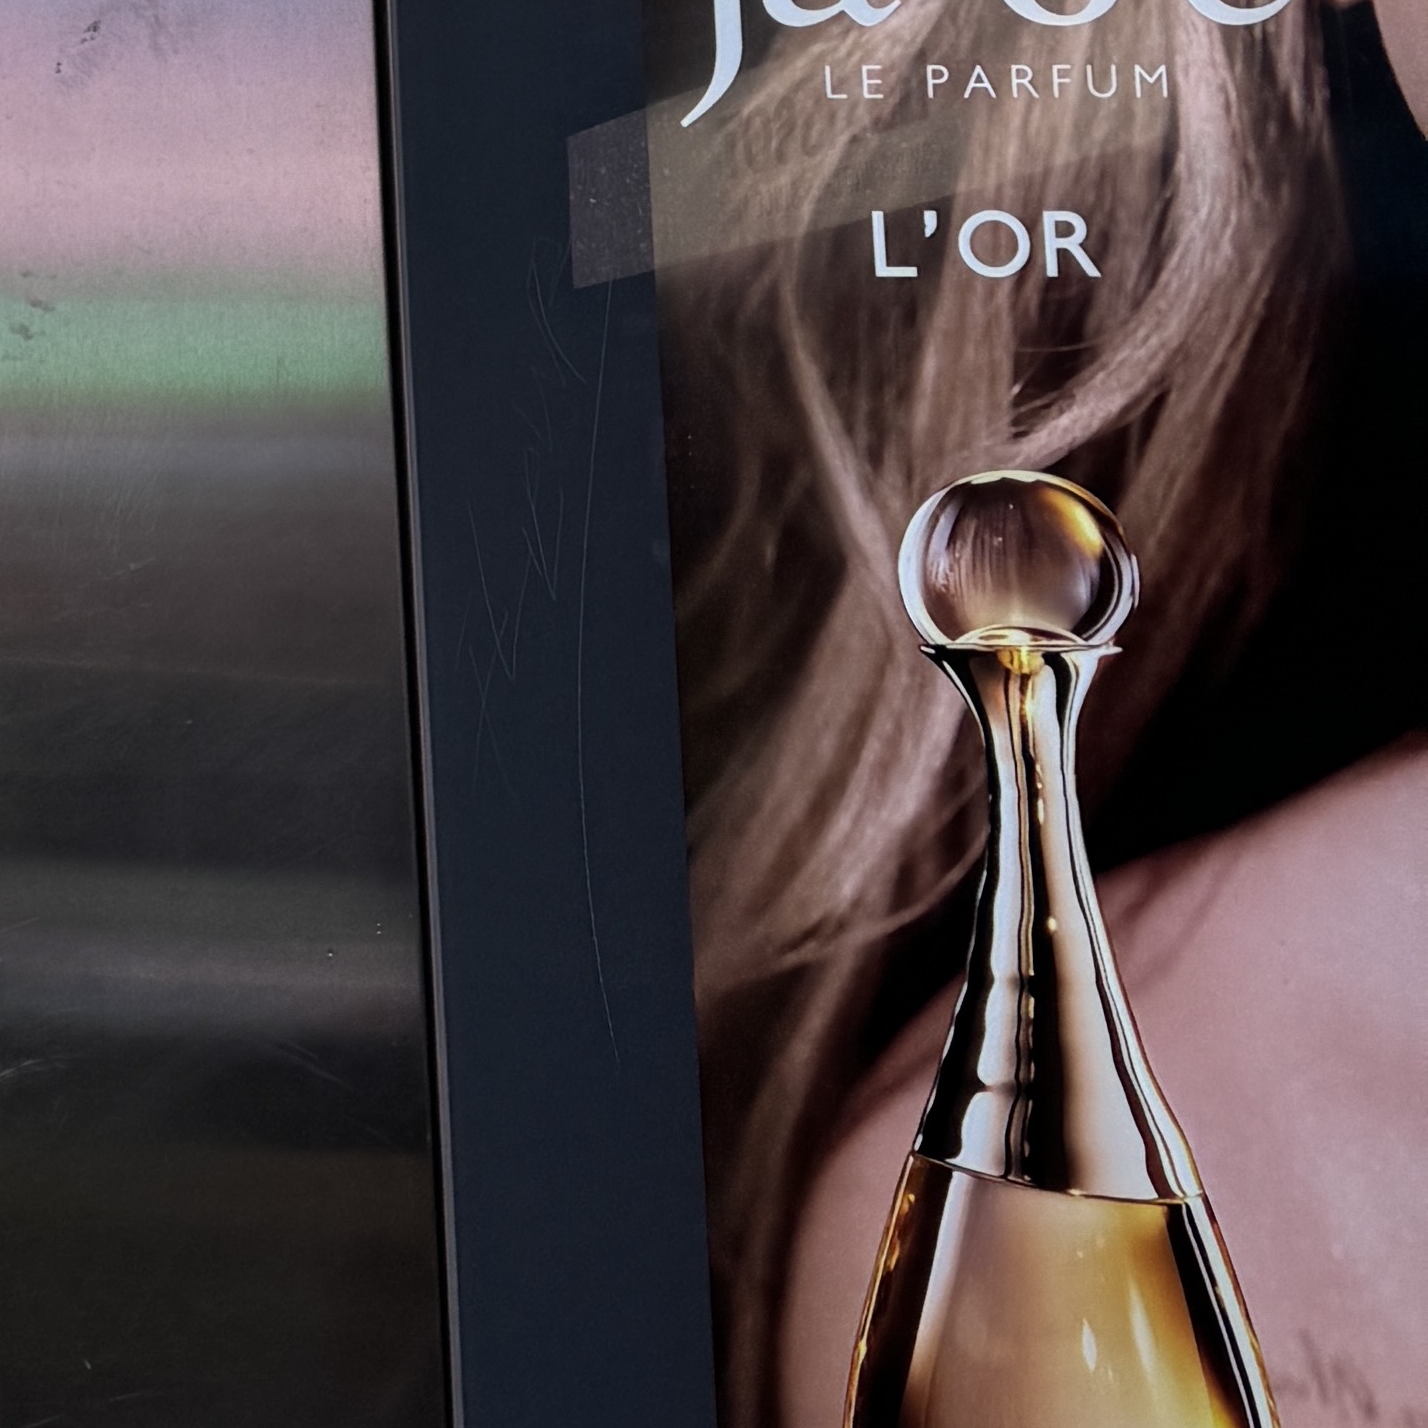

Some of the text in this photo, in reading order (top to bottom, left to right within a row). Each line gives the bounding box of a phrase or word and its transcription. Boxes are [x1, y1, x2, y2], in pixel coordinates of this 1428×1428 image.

[825, 65, 1170, 100] LE PARFUM
[871, 210, 1102, 279] L'OR
